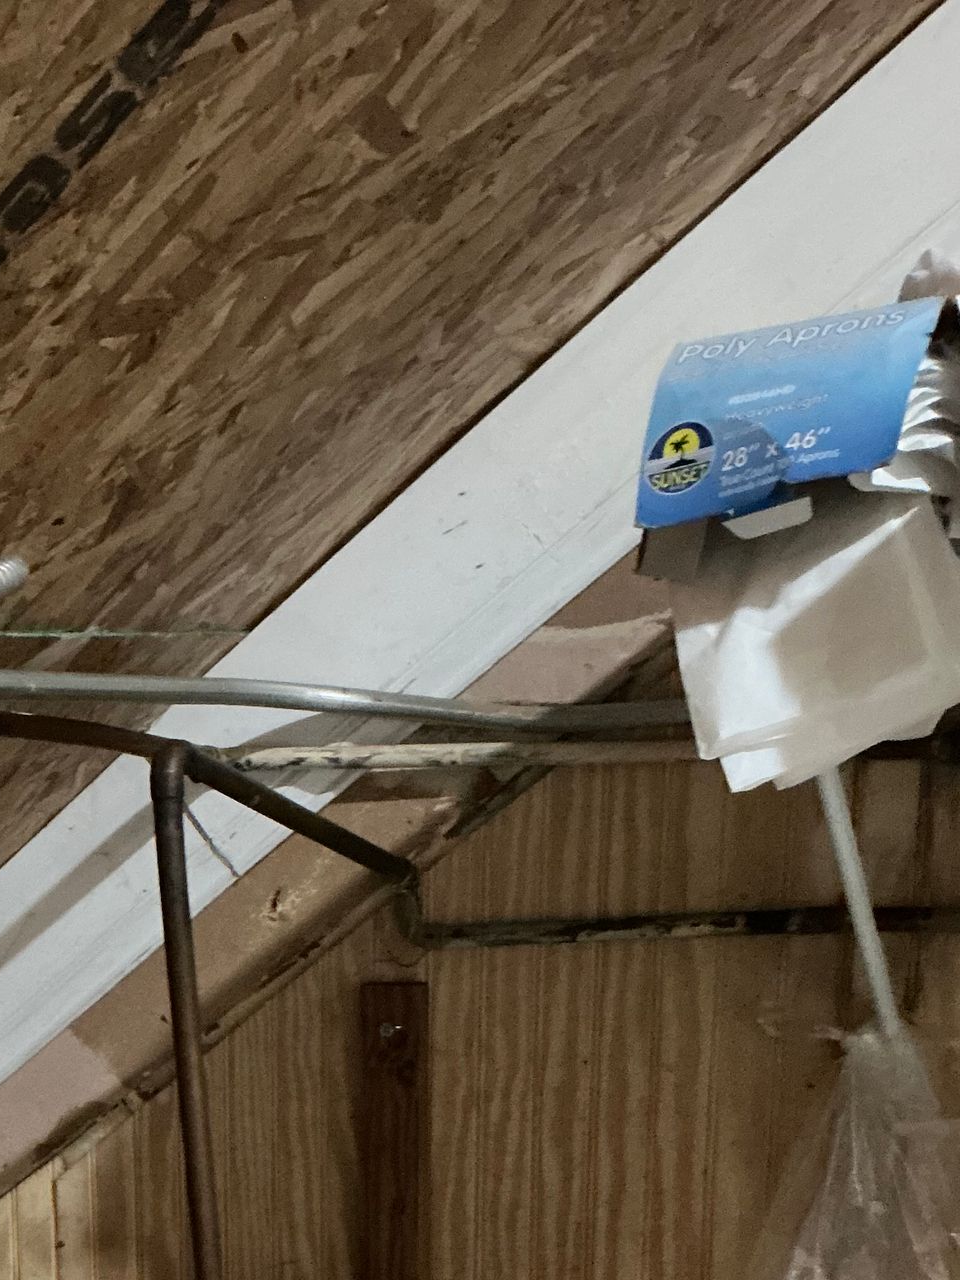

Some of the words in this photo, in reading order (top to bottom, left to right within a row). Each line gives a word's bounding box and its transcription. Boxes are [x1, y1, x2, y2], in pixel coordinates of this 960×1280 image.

[677, 336, 757, 364] Poly
[766, 310, 907, 348] Aprons
[783, 426, 832, 451] 46"
[650, 463, 709, 490] SUNSET
